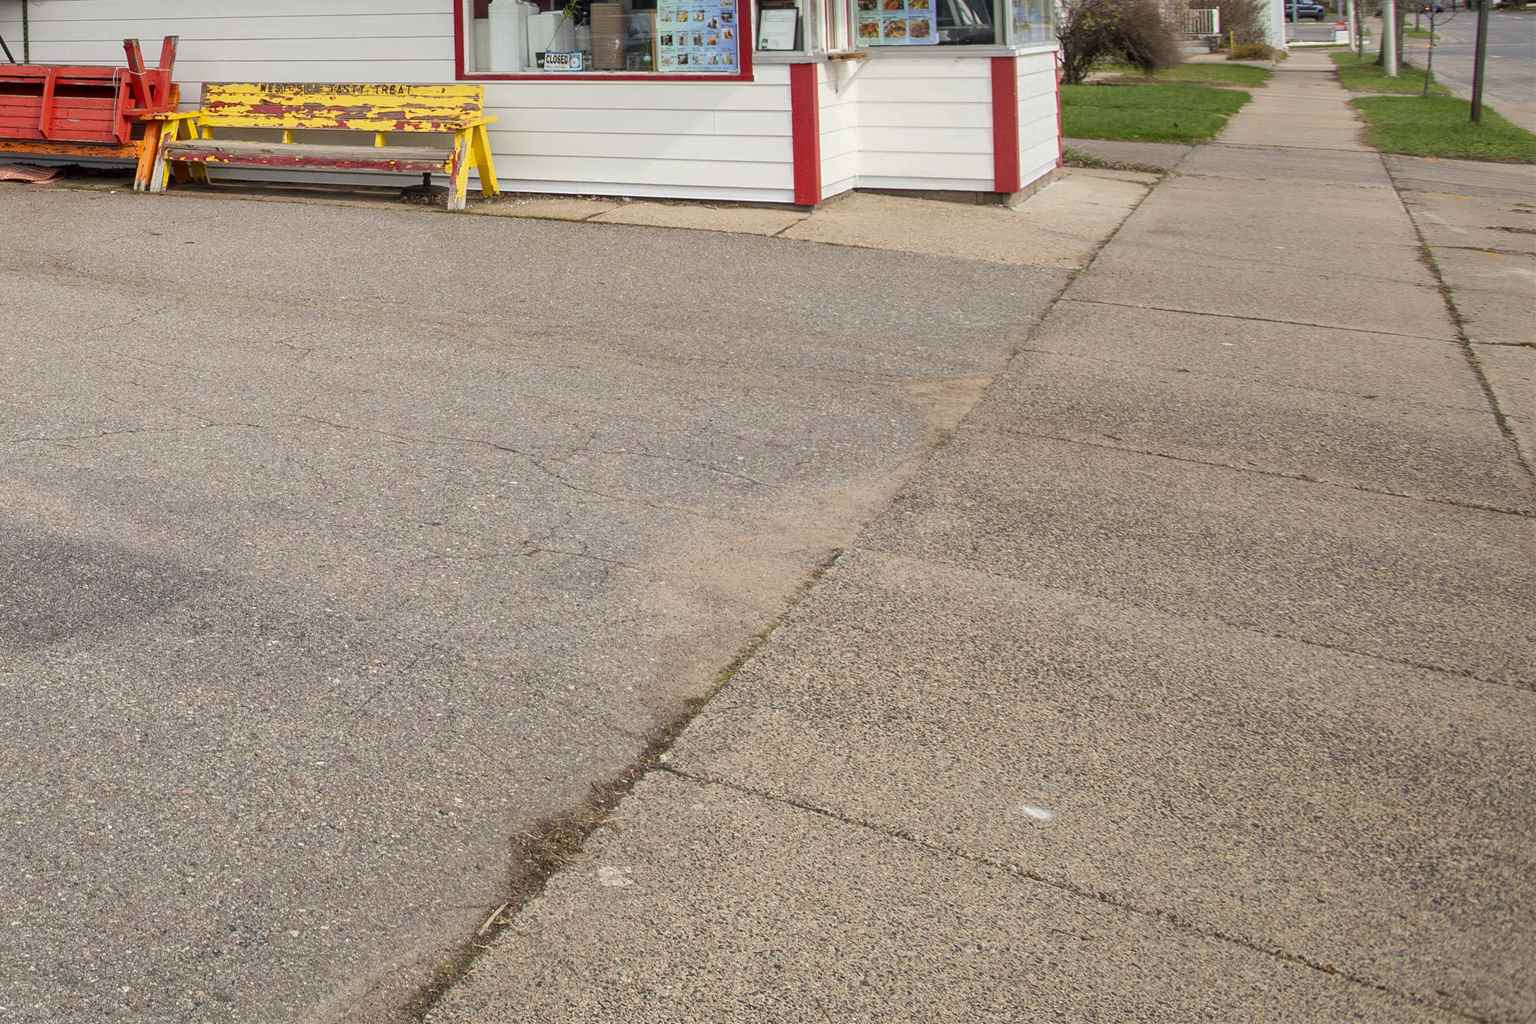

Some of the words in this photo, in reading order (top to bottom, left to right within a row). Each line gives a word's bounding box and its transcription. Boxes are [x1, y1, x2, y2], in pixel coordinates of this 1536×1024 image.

[545, 54, 569, 64] CLOSED
[329, 84, 365, 95] TASTY
[374, 84, 413, 95] TREAT
